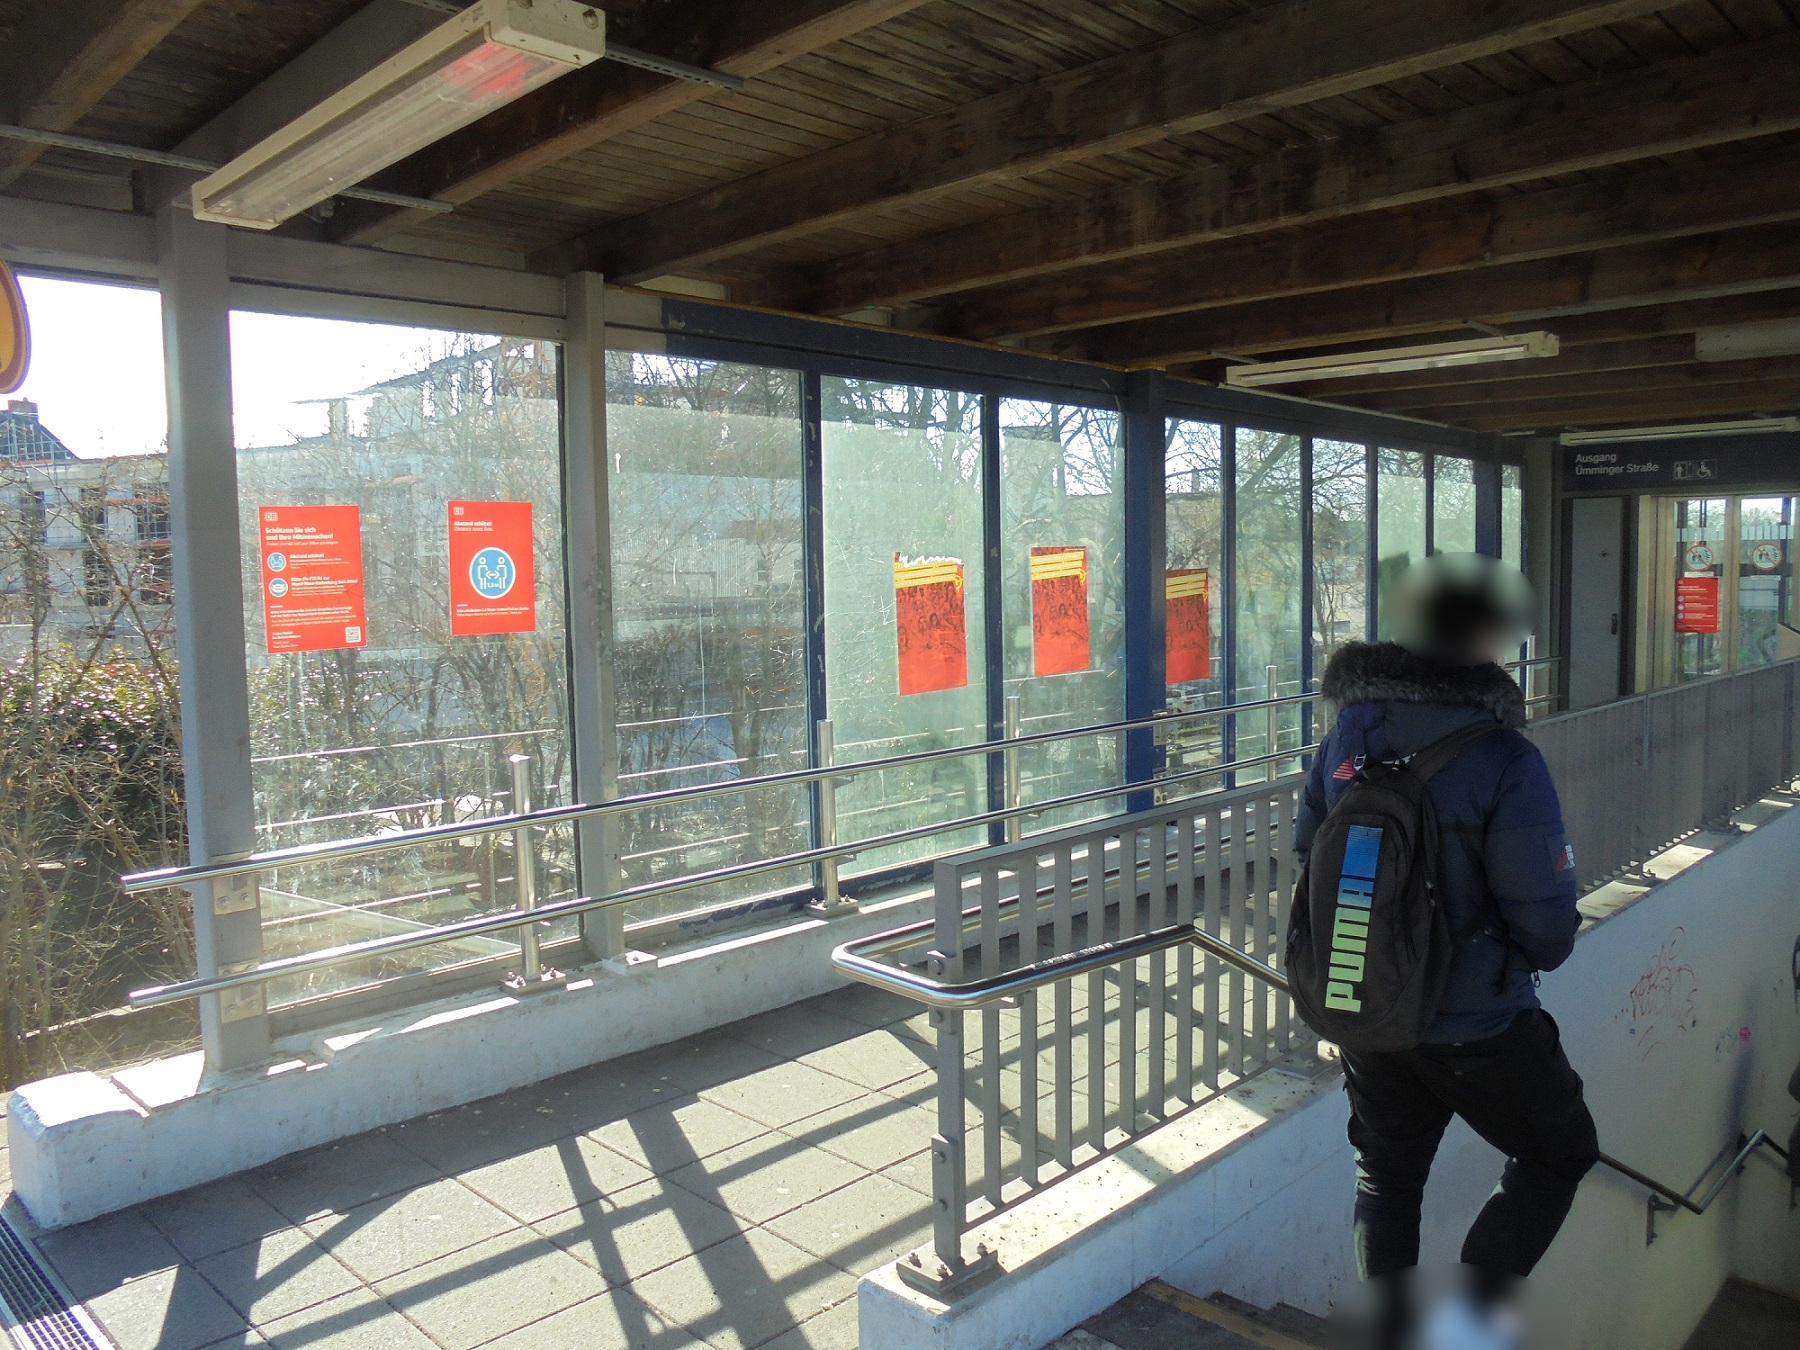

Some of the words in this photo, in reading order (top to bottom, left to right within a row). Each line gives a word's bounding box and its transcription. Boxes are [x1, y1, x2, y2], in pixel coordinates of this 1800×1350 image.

[1575, 454, 1617, 464] Ausgang
[1575, 464, 1624, 475] Ümminger
[1626, 462, 1659, 473] Straße
[1325, 877, 1374, 1013] PUMA
